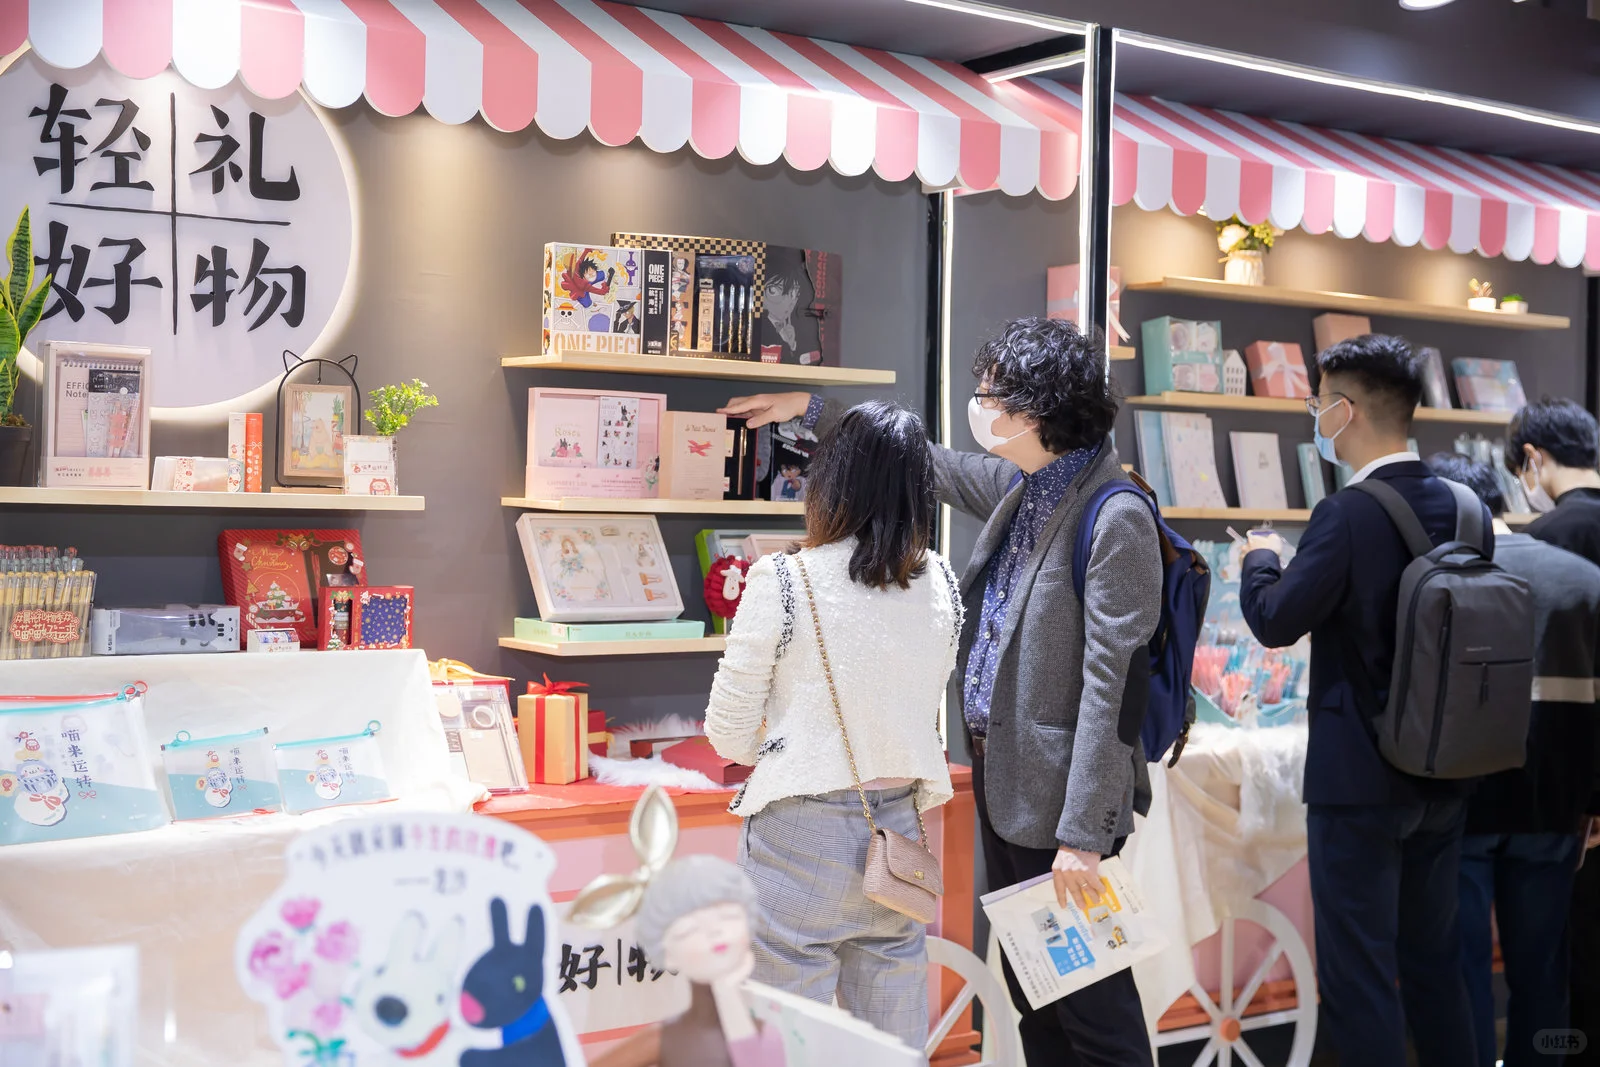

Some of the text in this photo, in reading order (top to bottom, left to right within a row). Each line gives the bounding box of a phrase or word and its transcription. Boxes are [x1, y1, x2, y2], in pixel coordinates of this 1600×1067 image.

[648, 263, 665, 275] ONE
[648, 274, 665, 284] PIECE
[61, 728, 93, 789] 喵来运转
